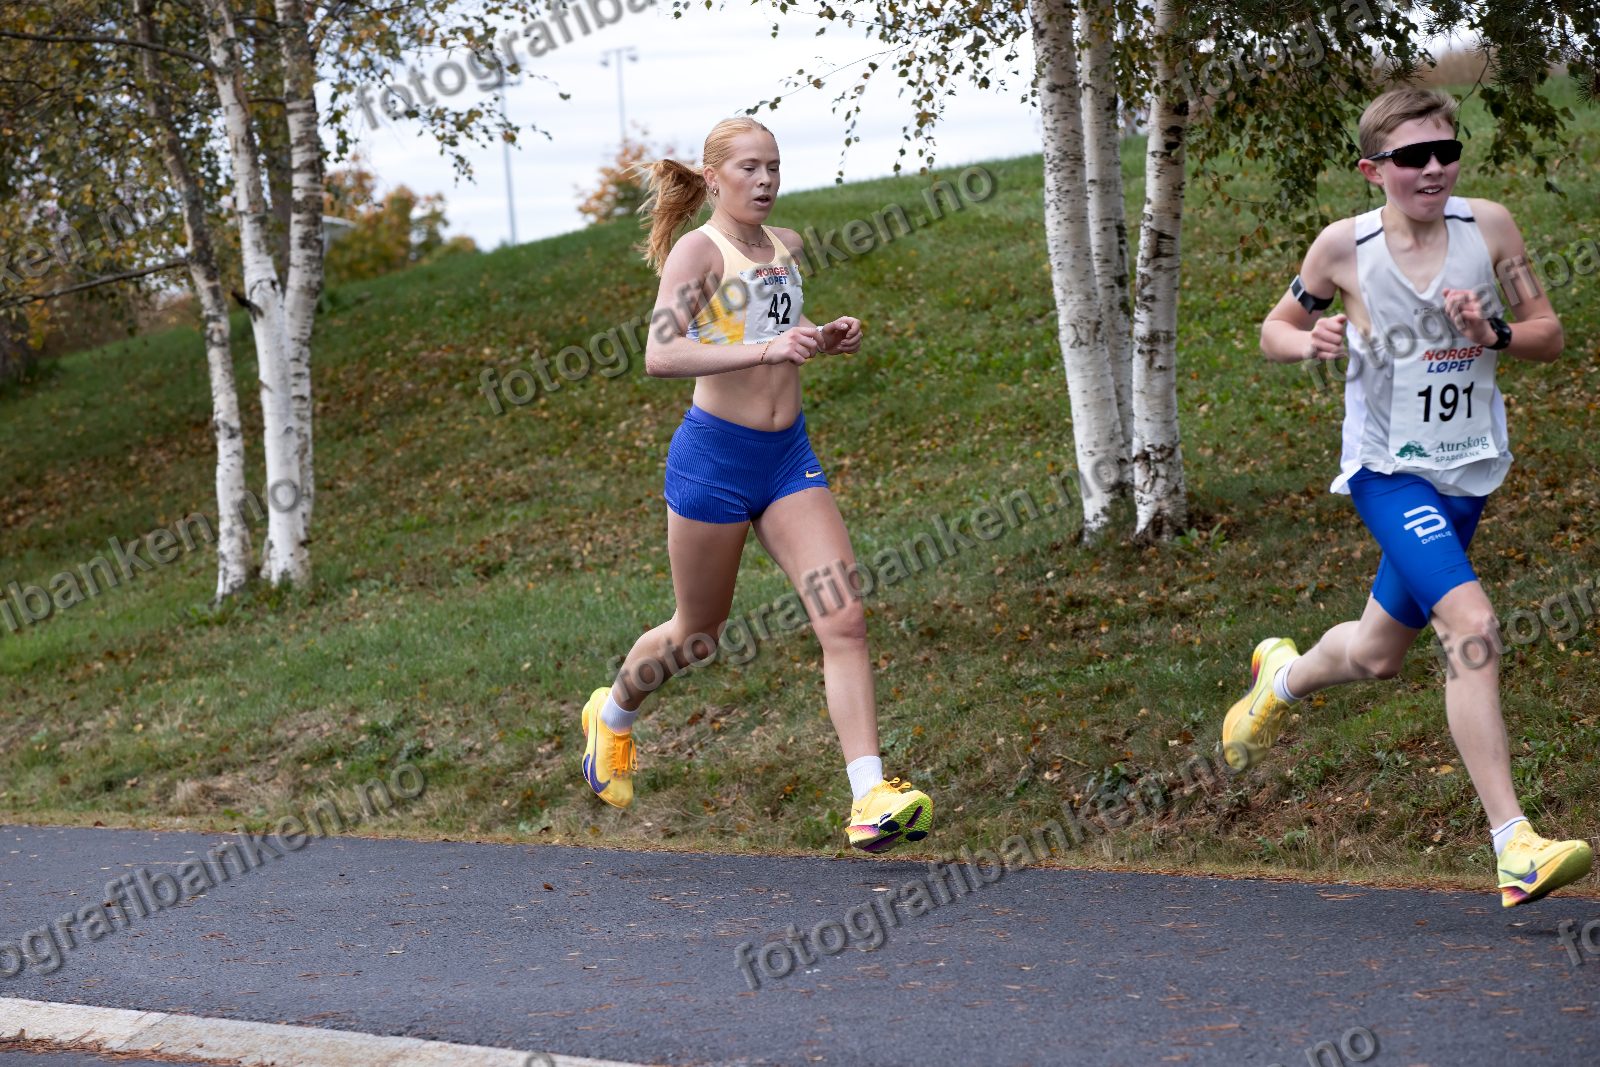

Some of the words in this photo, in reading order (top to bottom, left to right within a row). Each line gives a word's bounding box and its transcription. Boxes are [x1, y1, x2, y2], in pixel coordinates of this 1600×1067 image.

[755, 266, 790, 278] NORGES
[768, 292, 792, 325] 42
[1423, 345, 1484, 361] NORGES
[1427, 359, 1475, 373] LØPET
[1417, 381, 1475, 422] 191
[1435, 435, 1490, 453] Aurskog
